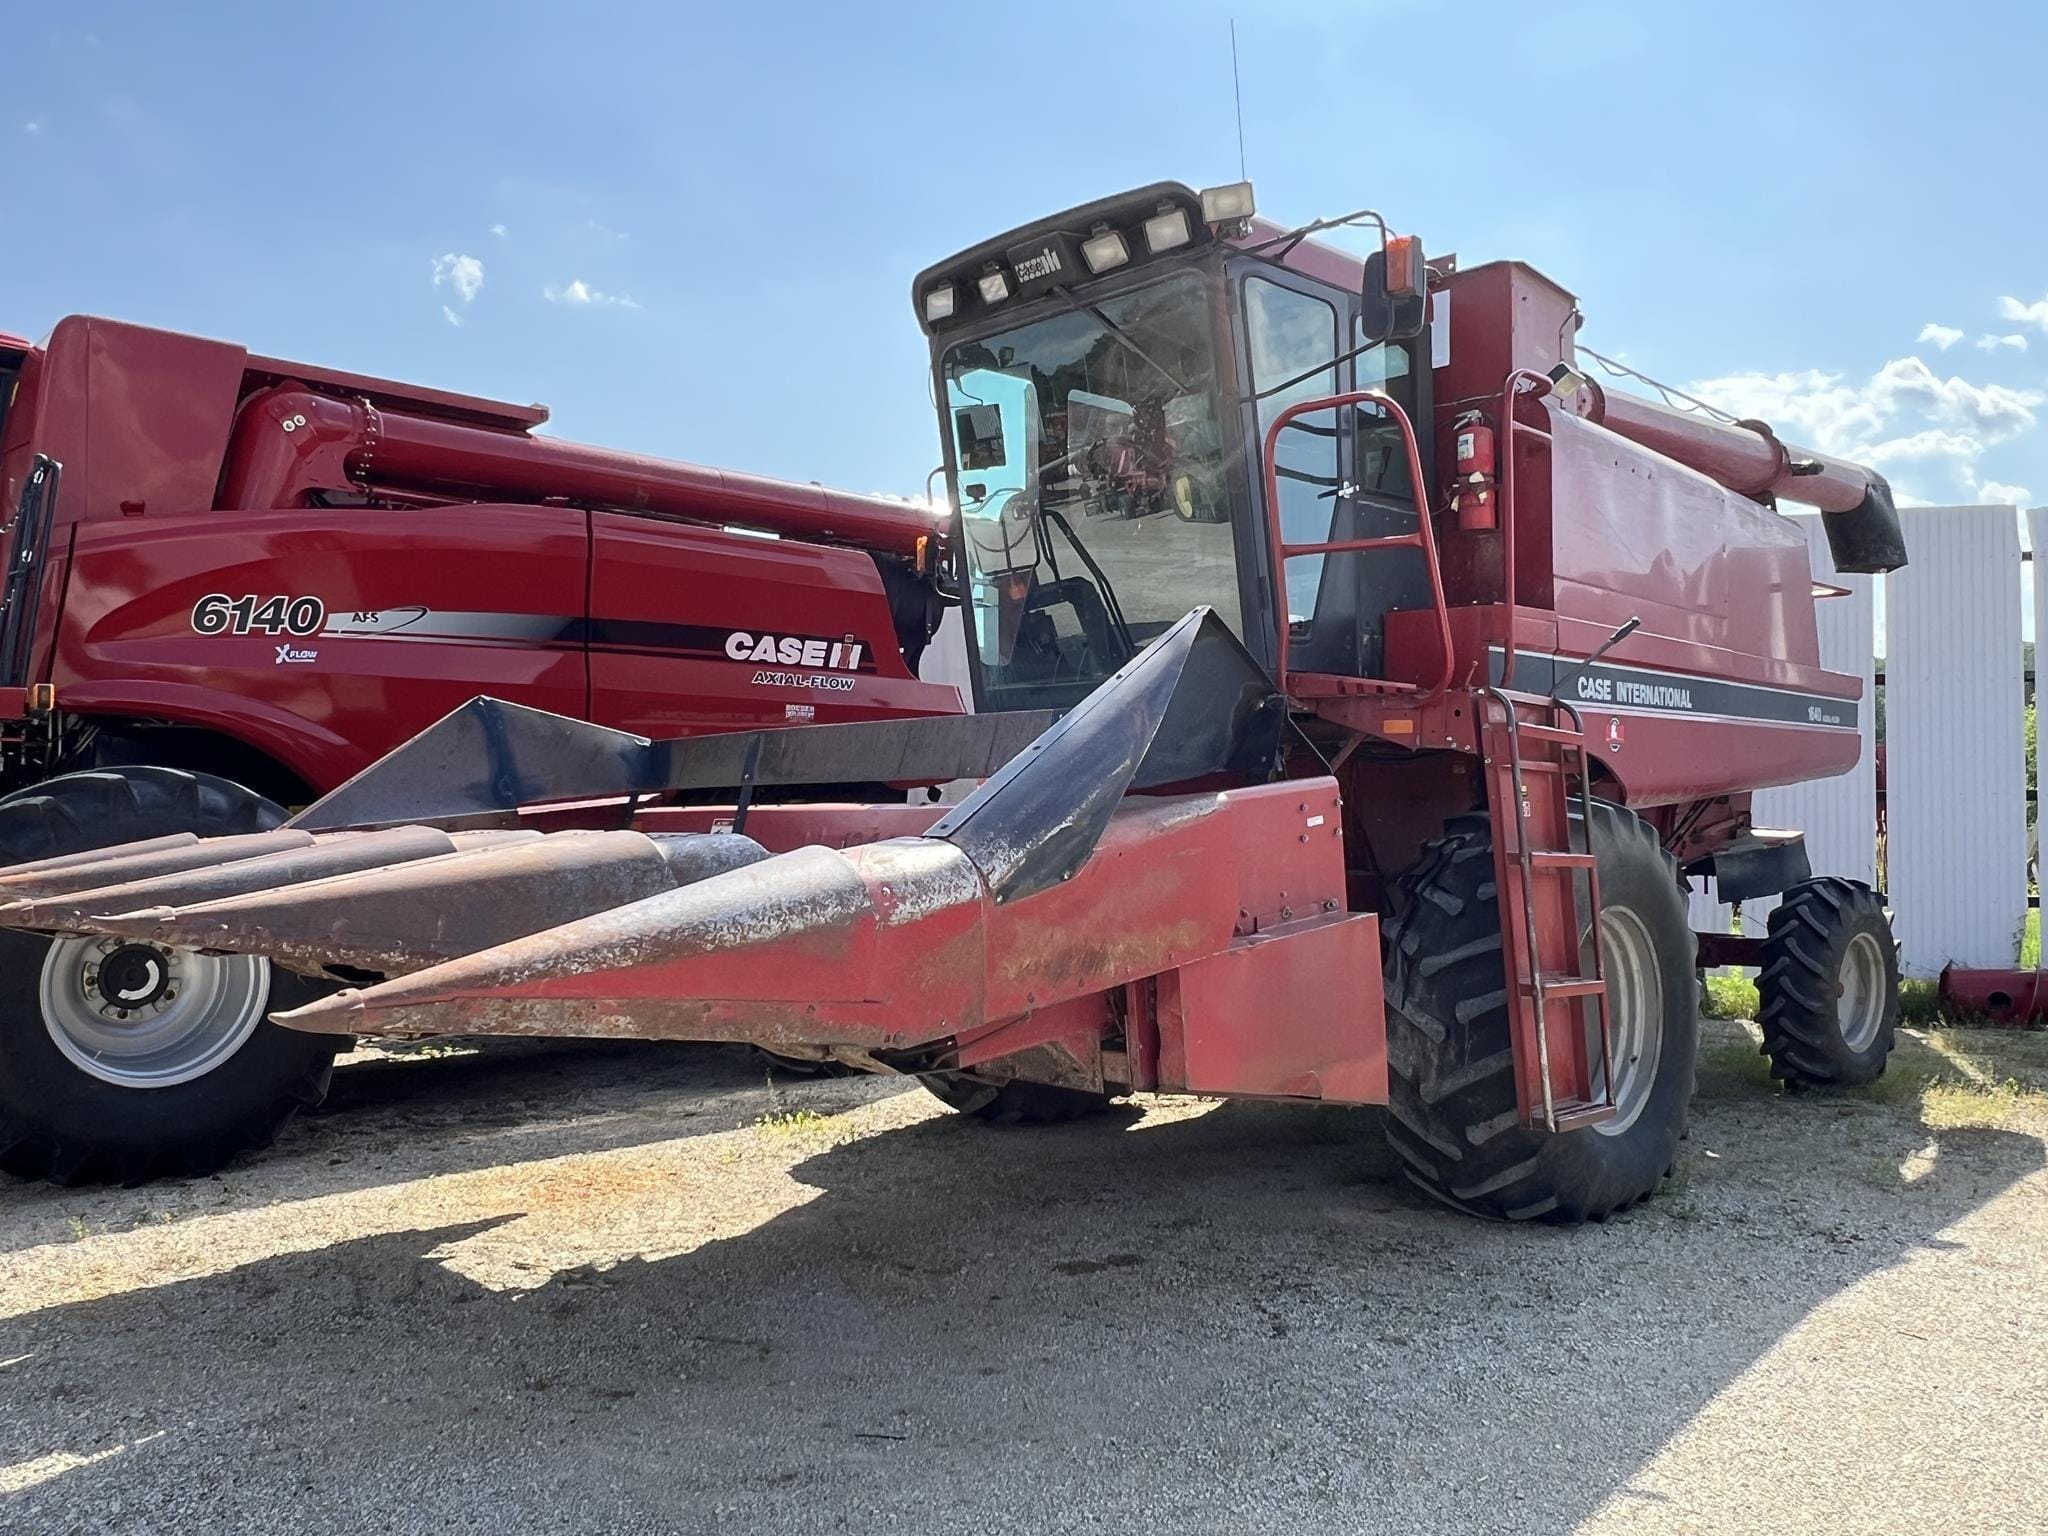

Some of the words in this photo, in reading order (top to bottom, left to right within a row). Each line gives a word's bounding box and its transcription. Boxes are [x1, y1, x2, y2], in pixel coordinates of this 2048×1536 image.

[191, 593, 325, 636] 6140
[352, 611, 379, 624] AFS
[725, 632, 828, 667] CASE
[752, 671, 855, 691] AXIAL-FLOW
[1578, 676, 1612, 701] CASE
[1616, 681, 1692, 709] INTERNATIONAL
